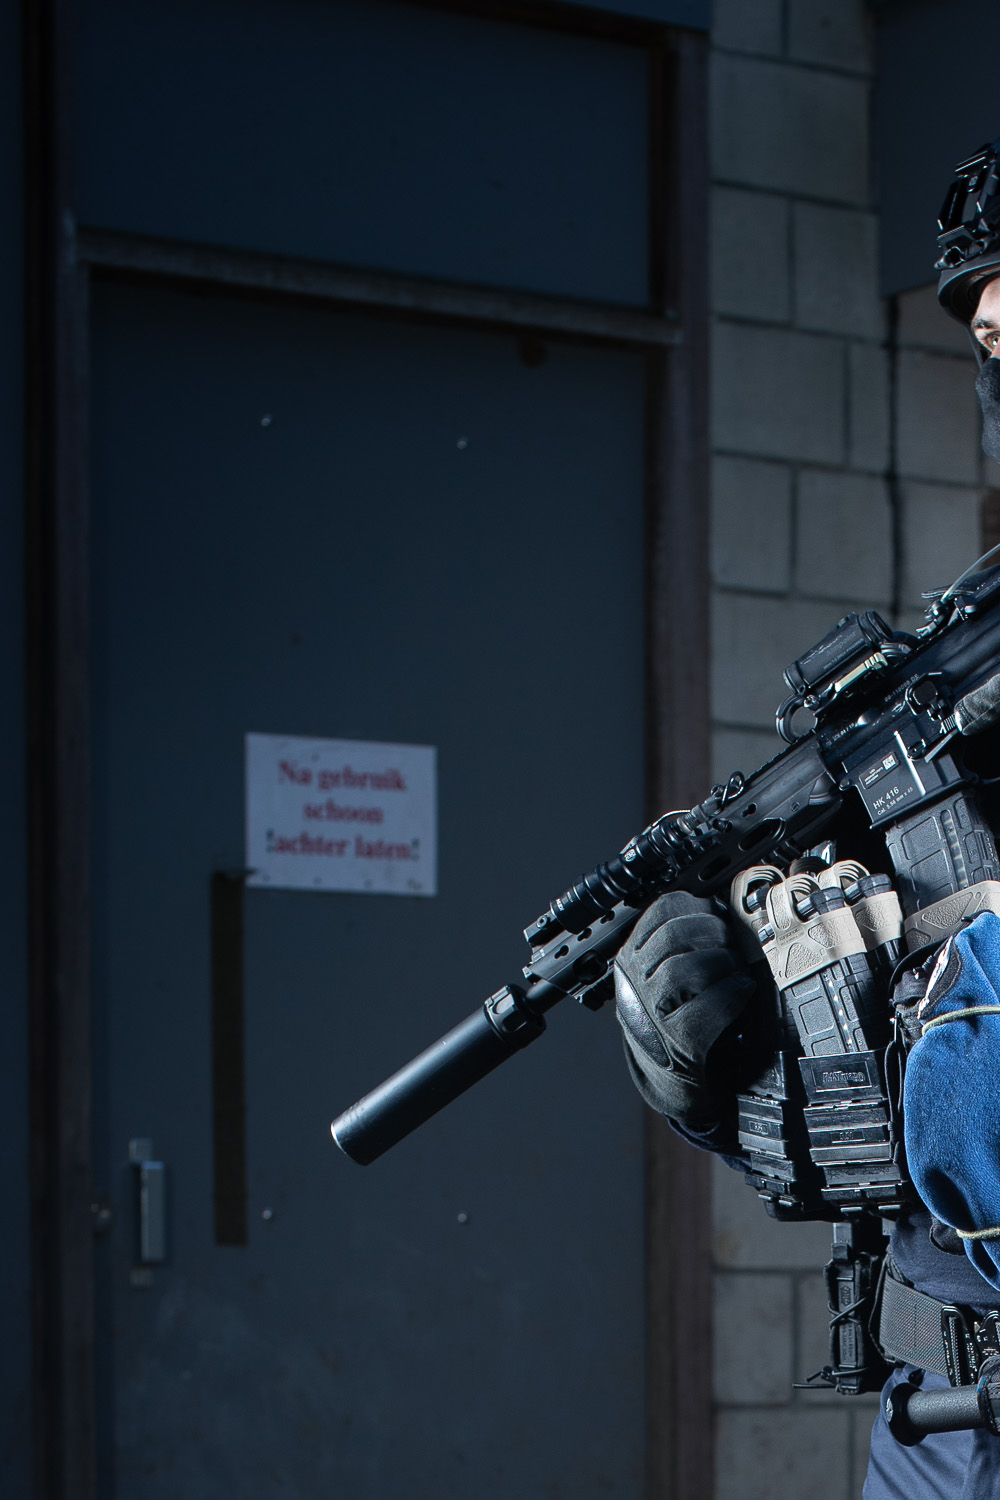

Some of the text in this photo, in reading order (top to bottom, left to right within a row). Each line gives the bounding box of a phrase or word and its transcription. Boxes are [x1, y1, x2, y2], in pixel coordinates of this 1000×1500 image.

[278, 760, 407, 791] Na gebruik
[873, 786, 899, 809] HK 416
[303, 799, 384, 824] schoon
[354, 835, 420, 861] laten!
